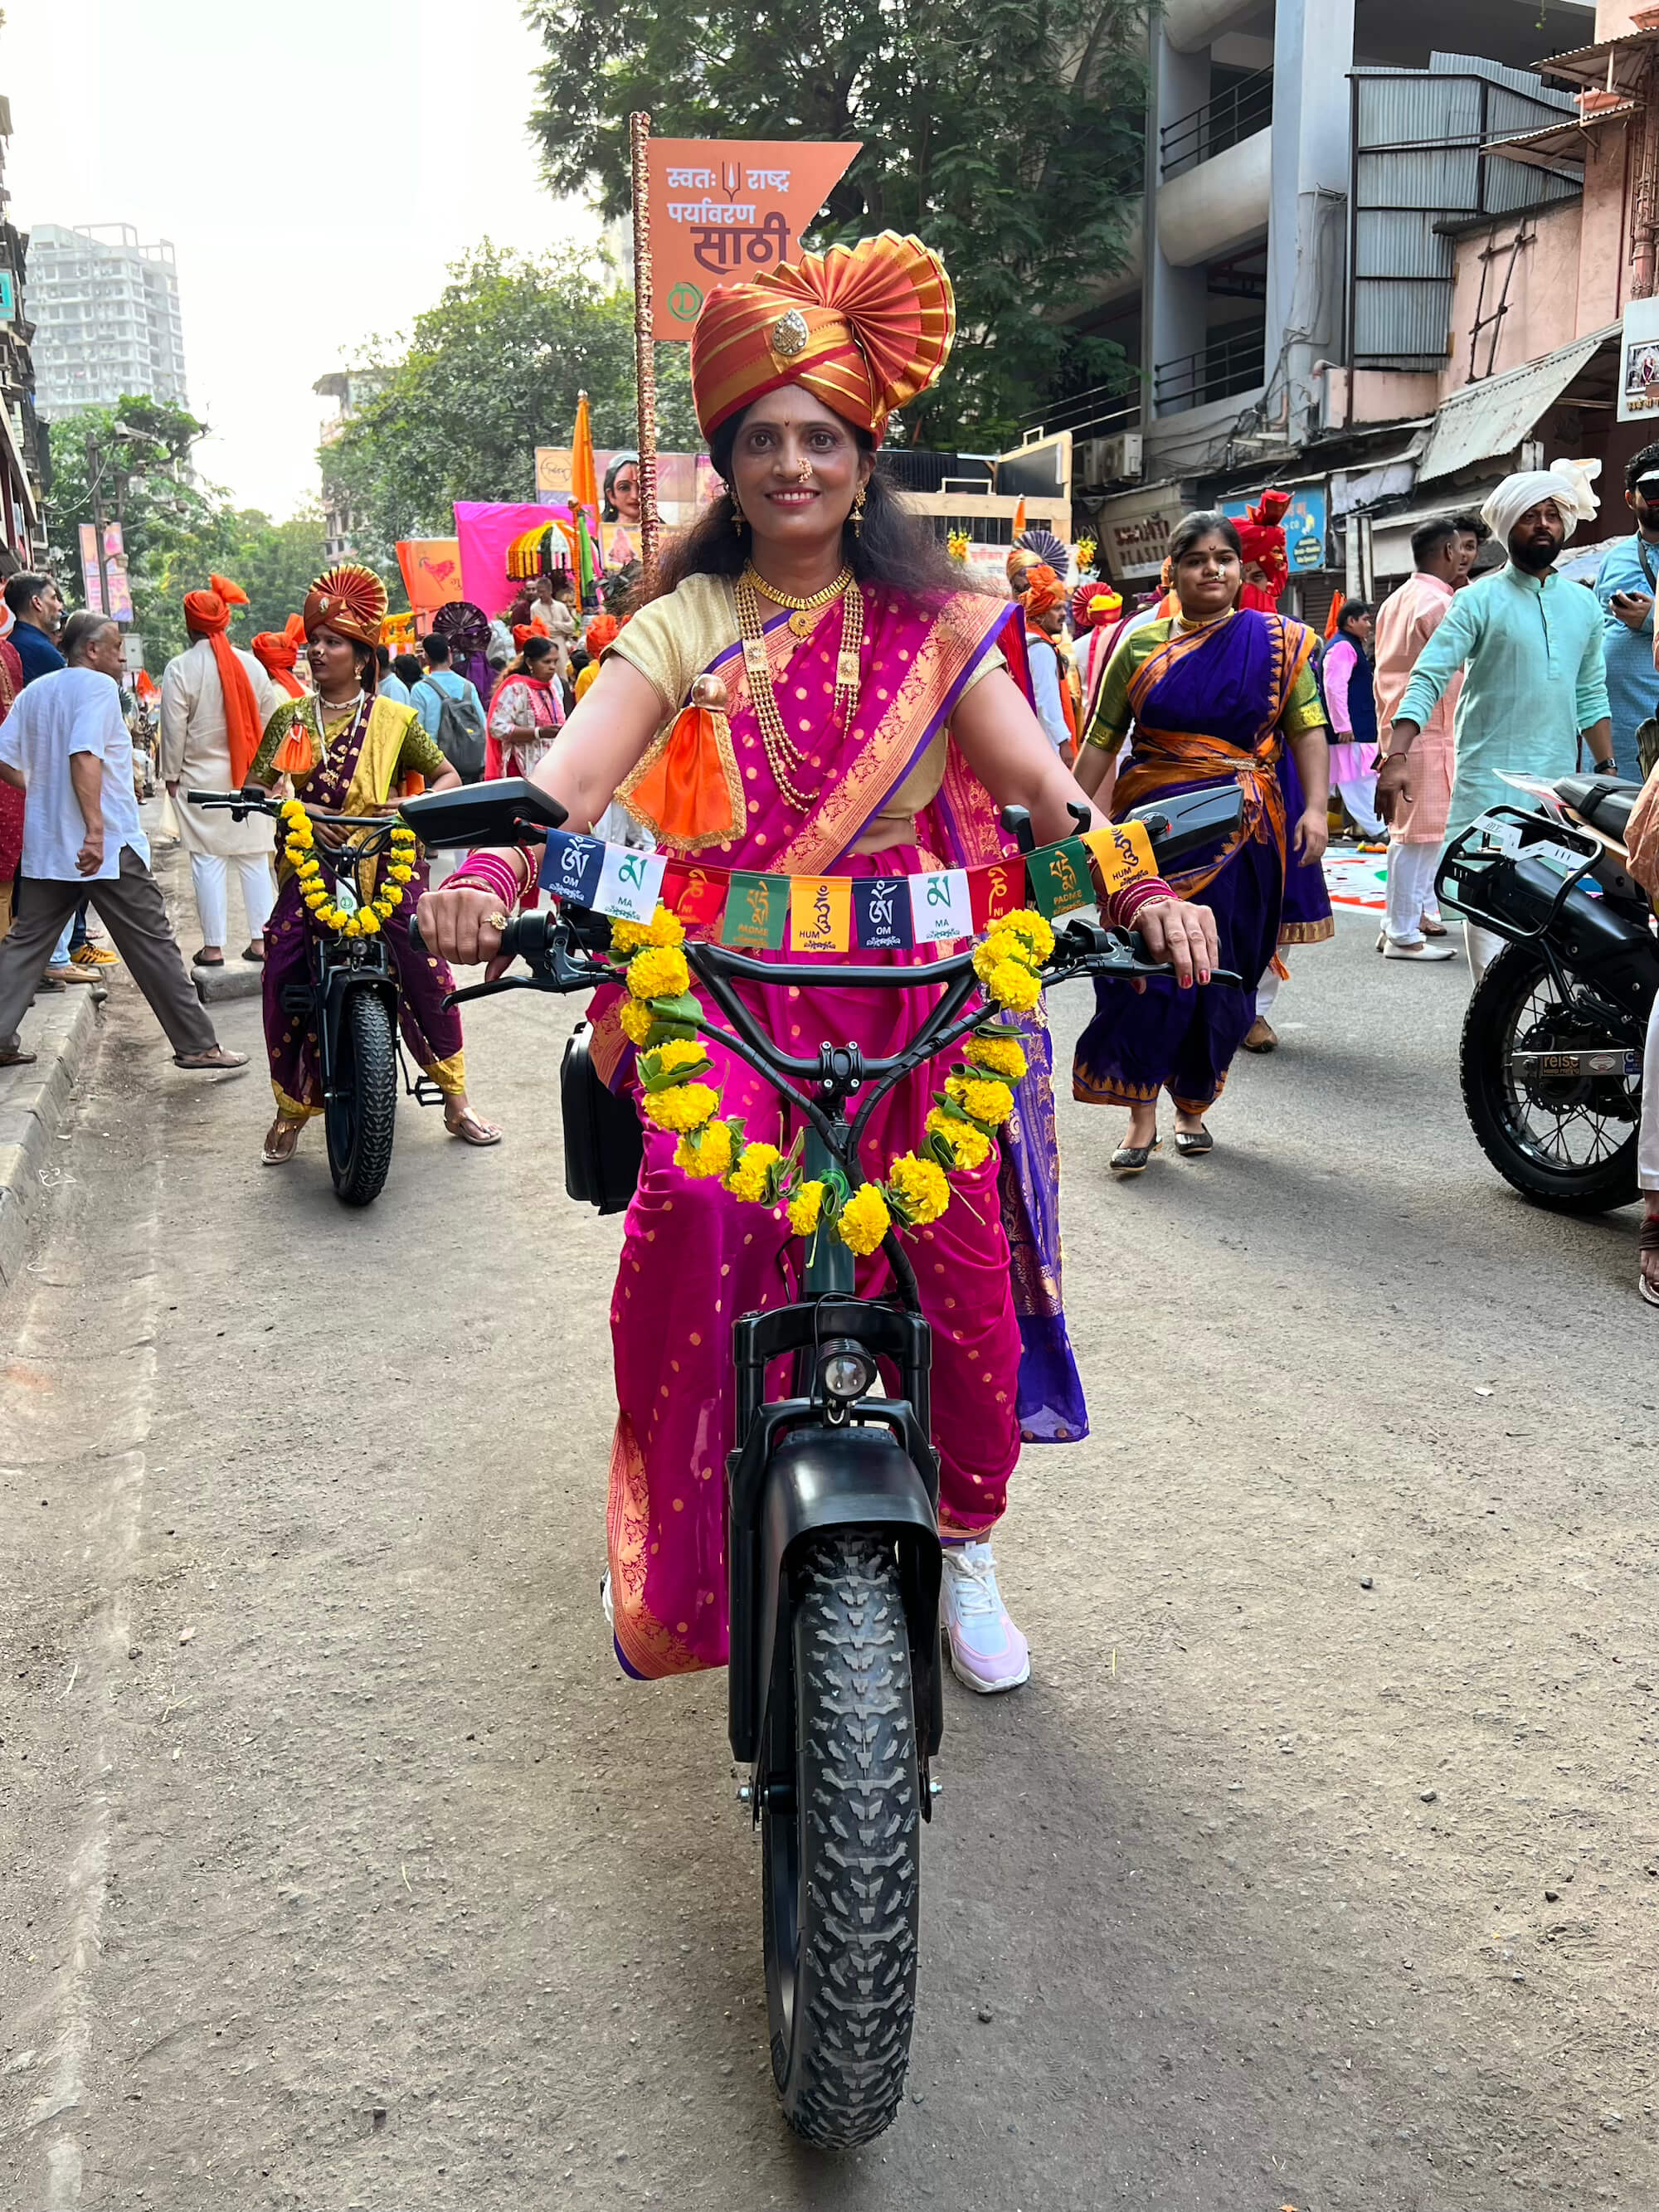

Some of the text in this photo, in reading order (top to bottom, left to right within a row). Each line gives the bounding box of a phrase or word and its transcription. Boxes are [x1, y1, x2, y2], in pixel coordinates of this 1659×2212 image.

[665, 168, 791, 192] स्वतः राष्ट्र
[666, 197, 757, 224] पर्यावरण
[689, 211, 791, 275] साठी
[1112, 867, 1132, 881] HUM
[562, 875, 579, 887] OM
[618, 897, 633, 907] MA
[1053, 889, 1082, 905] PADME
[993, 907, 1004, 916] NI
[935, 918, 949, 928] MA
[799, 930, 820, 939] HUM
[876, 926, 892, 936] OM
